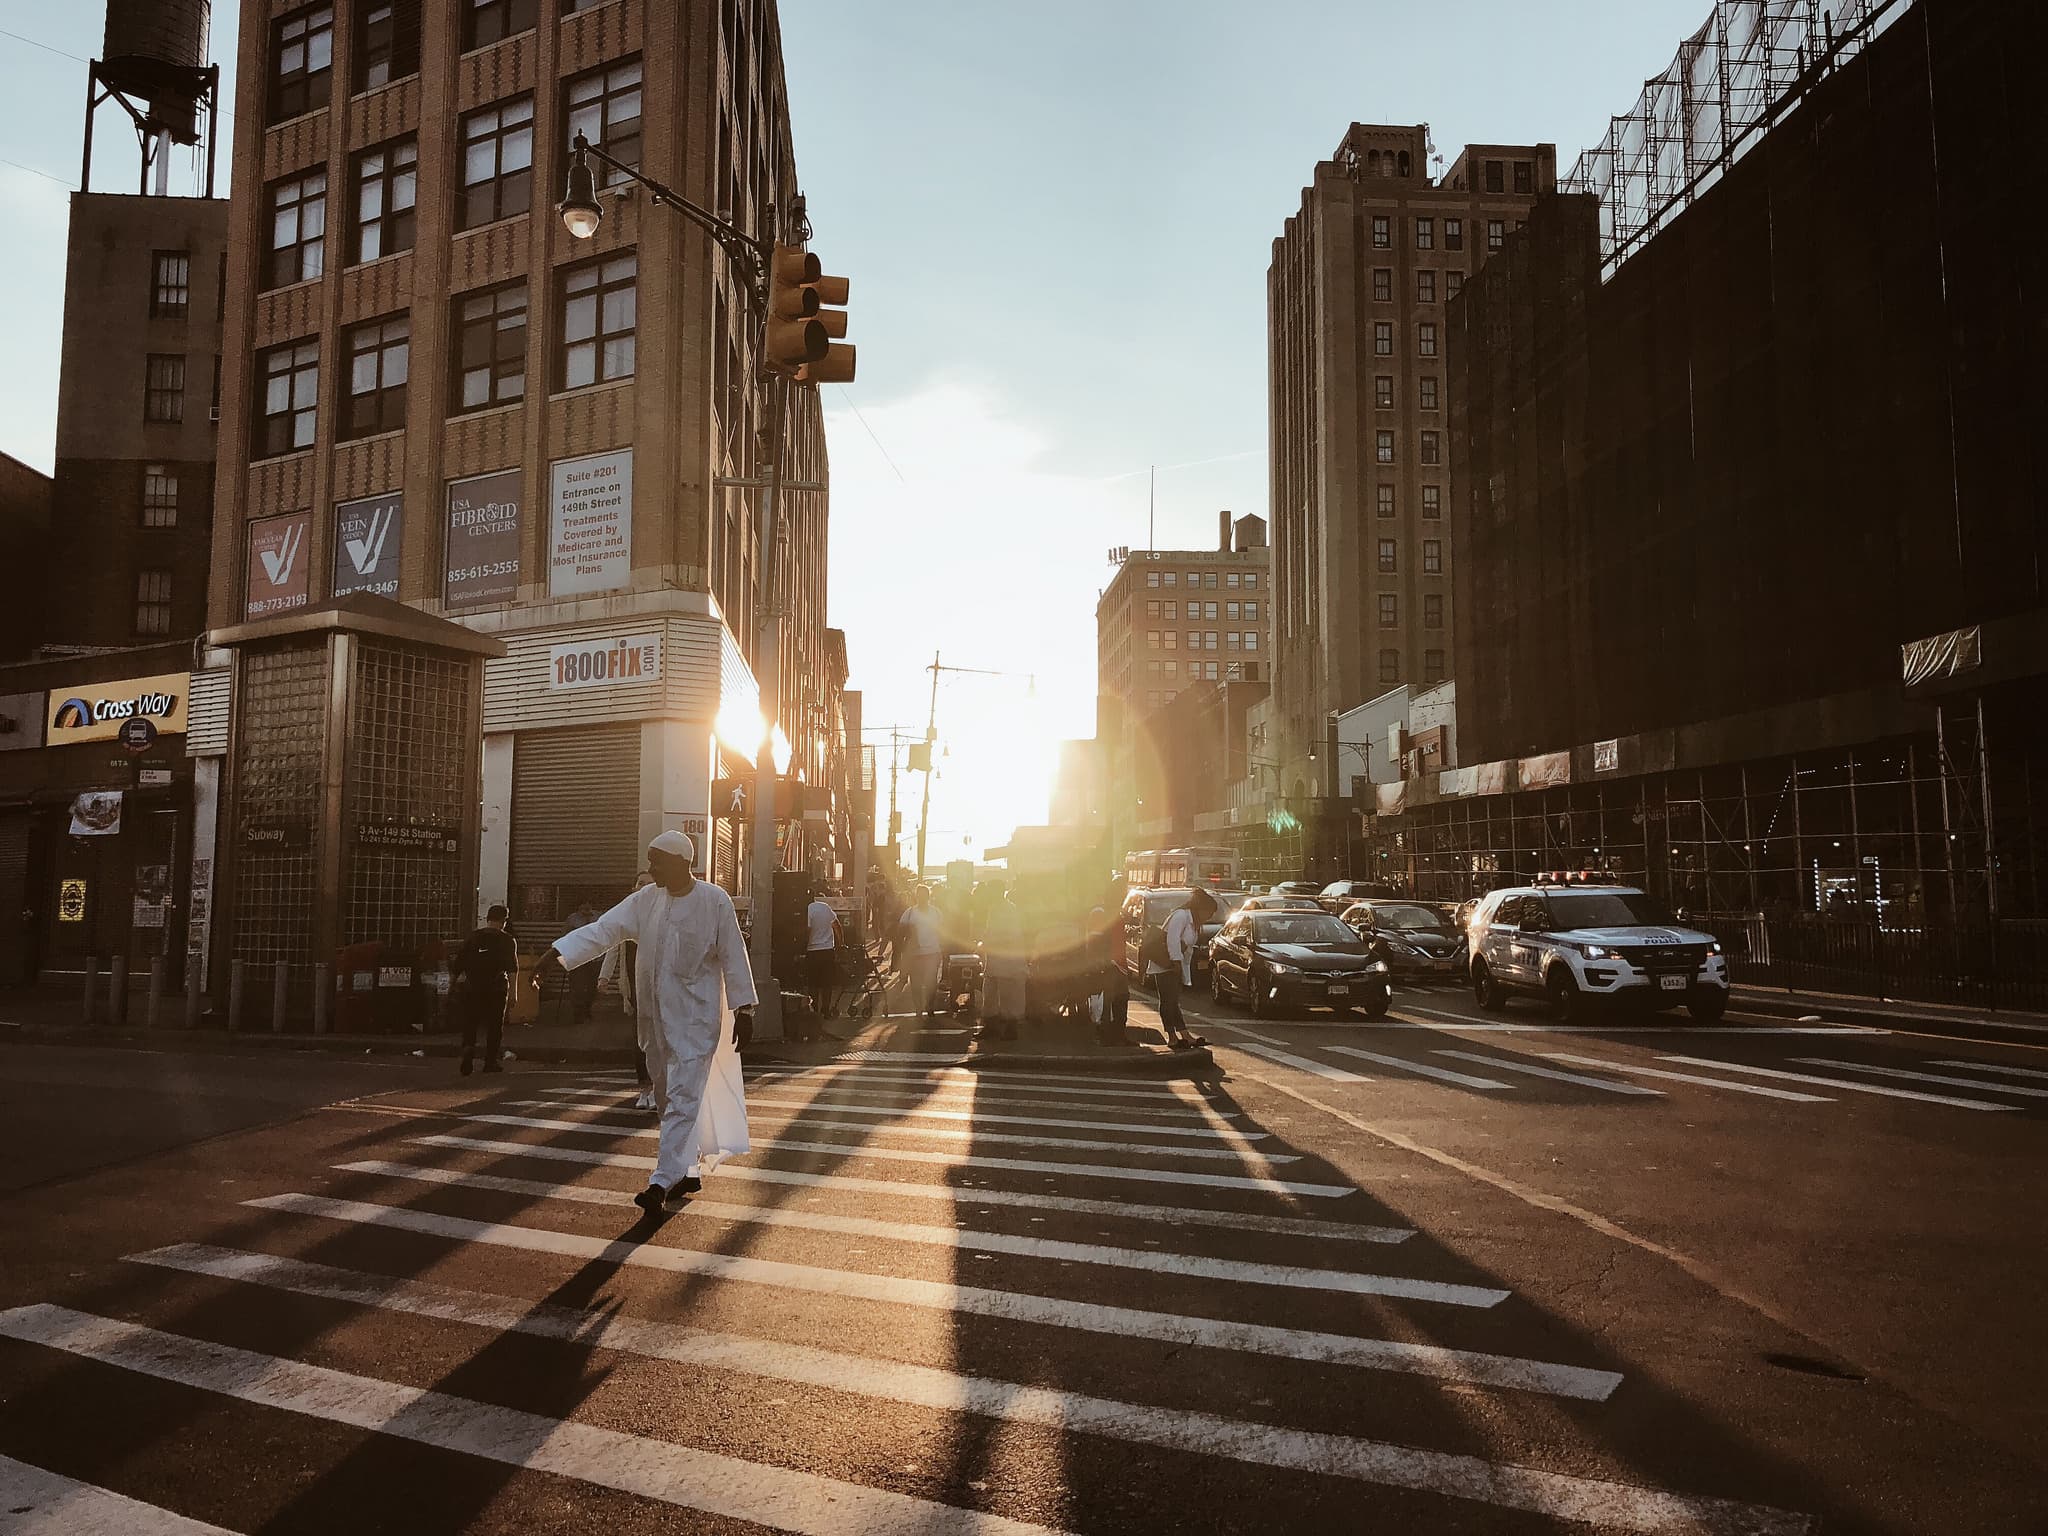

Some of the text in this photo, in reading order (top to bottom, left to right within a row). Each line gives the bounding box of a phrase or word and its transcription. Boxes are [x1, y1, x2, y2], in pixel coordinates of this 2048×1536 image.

[566, 466, 617, 484] Suite #201
[562, 483, 621, 500] Entrance on
[452, 499, 470, 511] USA
[561, 496, 622, 514] 149th Street
[341, 518, 368, 532] VEIN
[468, 520, 517, 536] CENTERS
[563, 511, 618, 528] Treatments
[564, 524, 618, 541] Covered by
[558, 535, 622, 554] Medicare and
[552, 548, 627, 567] Most Insurance
[448, 560, 518, 582] 855-615-2555
[576, 564, 602, 576] Plans
[248, 594, 307, 614] 888-773-2193
[643, 645, 654, 674] .COM
[94, 691, 172, 720] Cross Way
[248, 828, 285, 842] Subway
[360, 825, 366, 834] 3
[400, 828, 410, 838] St
[412, 828, 441, 840] Station
